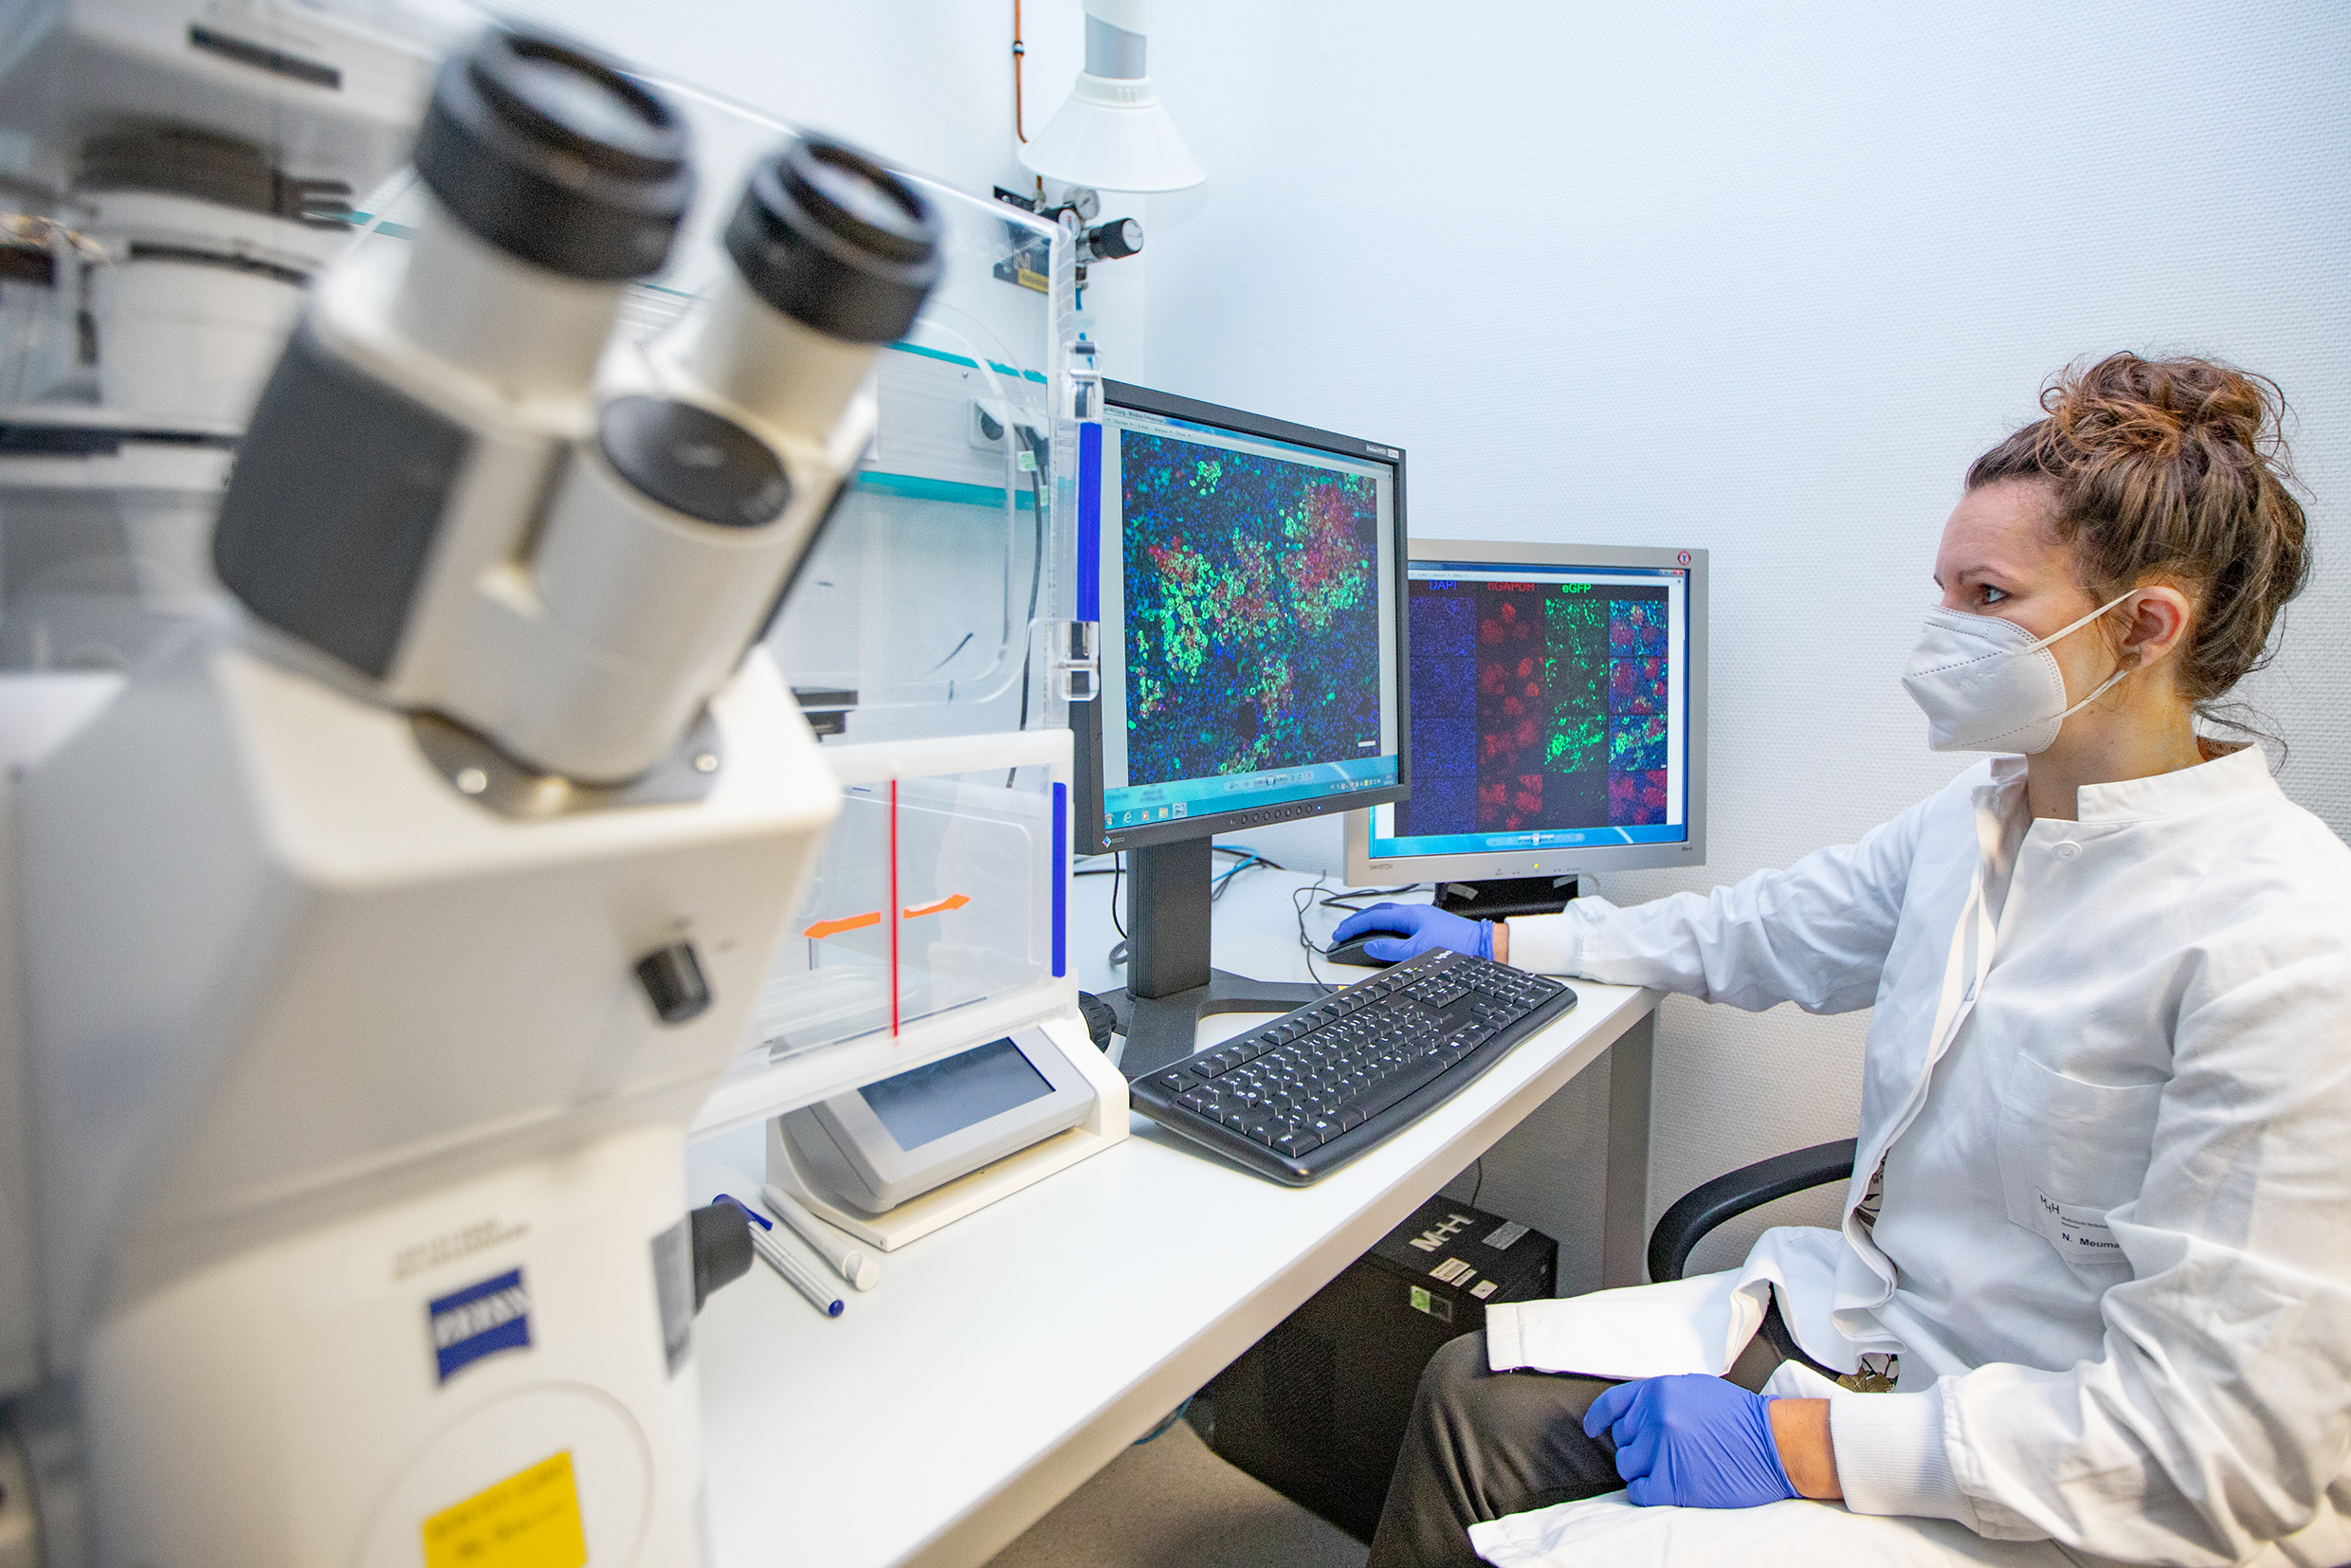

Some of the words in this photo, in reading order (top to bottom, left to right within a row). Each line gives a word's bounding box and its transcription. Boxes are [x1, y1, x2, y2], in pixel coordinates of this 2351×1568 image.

[1429, 579, 1457, 591] DAPI
[1562, 583, 1592, 593] eGFP
[2062, 1232, 2073, 1242] N.
